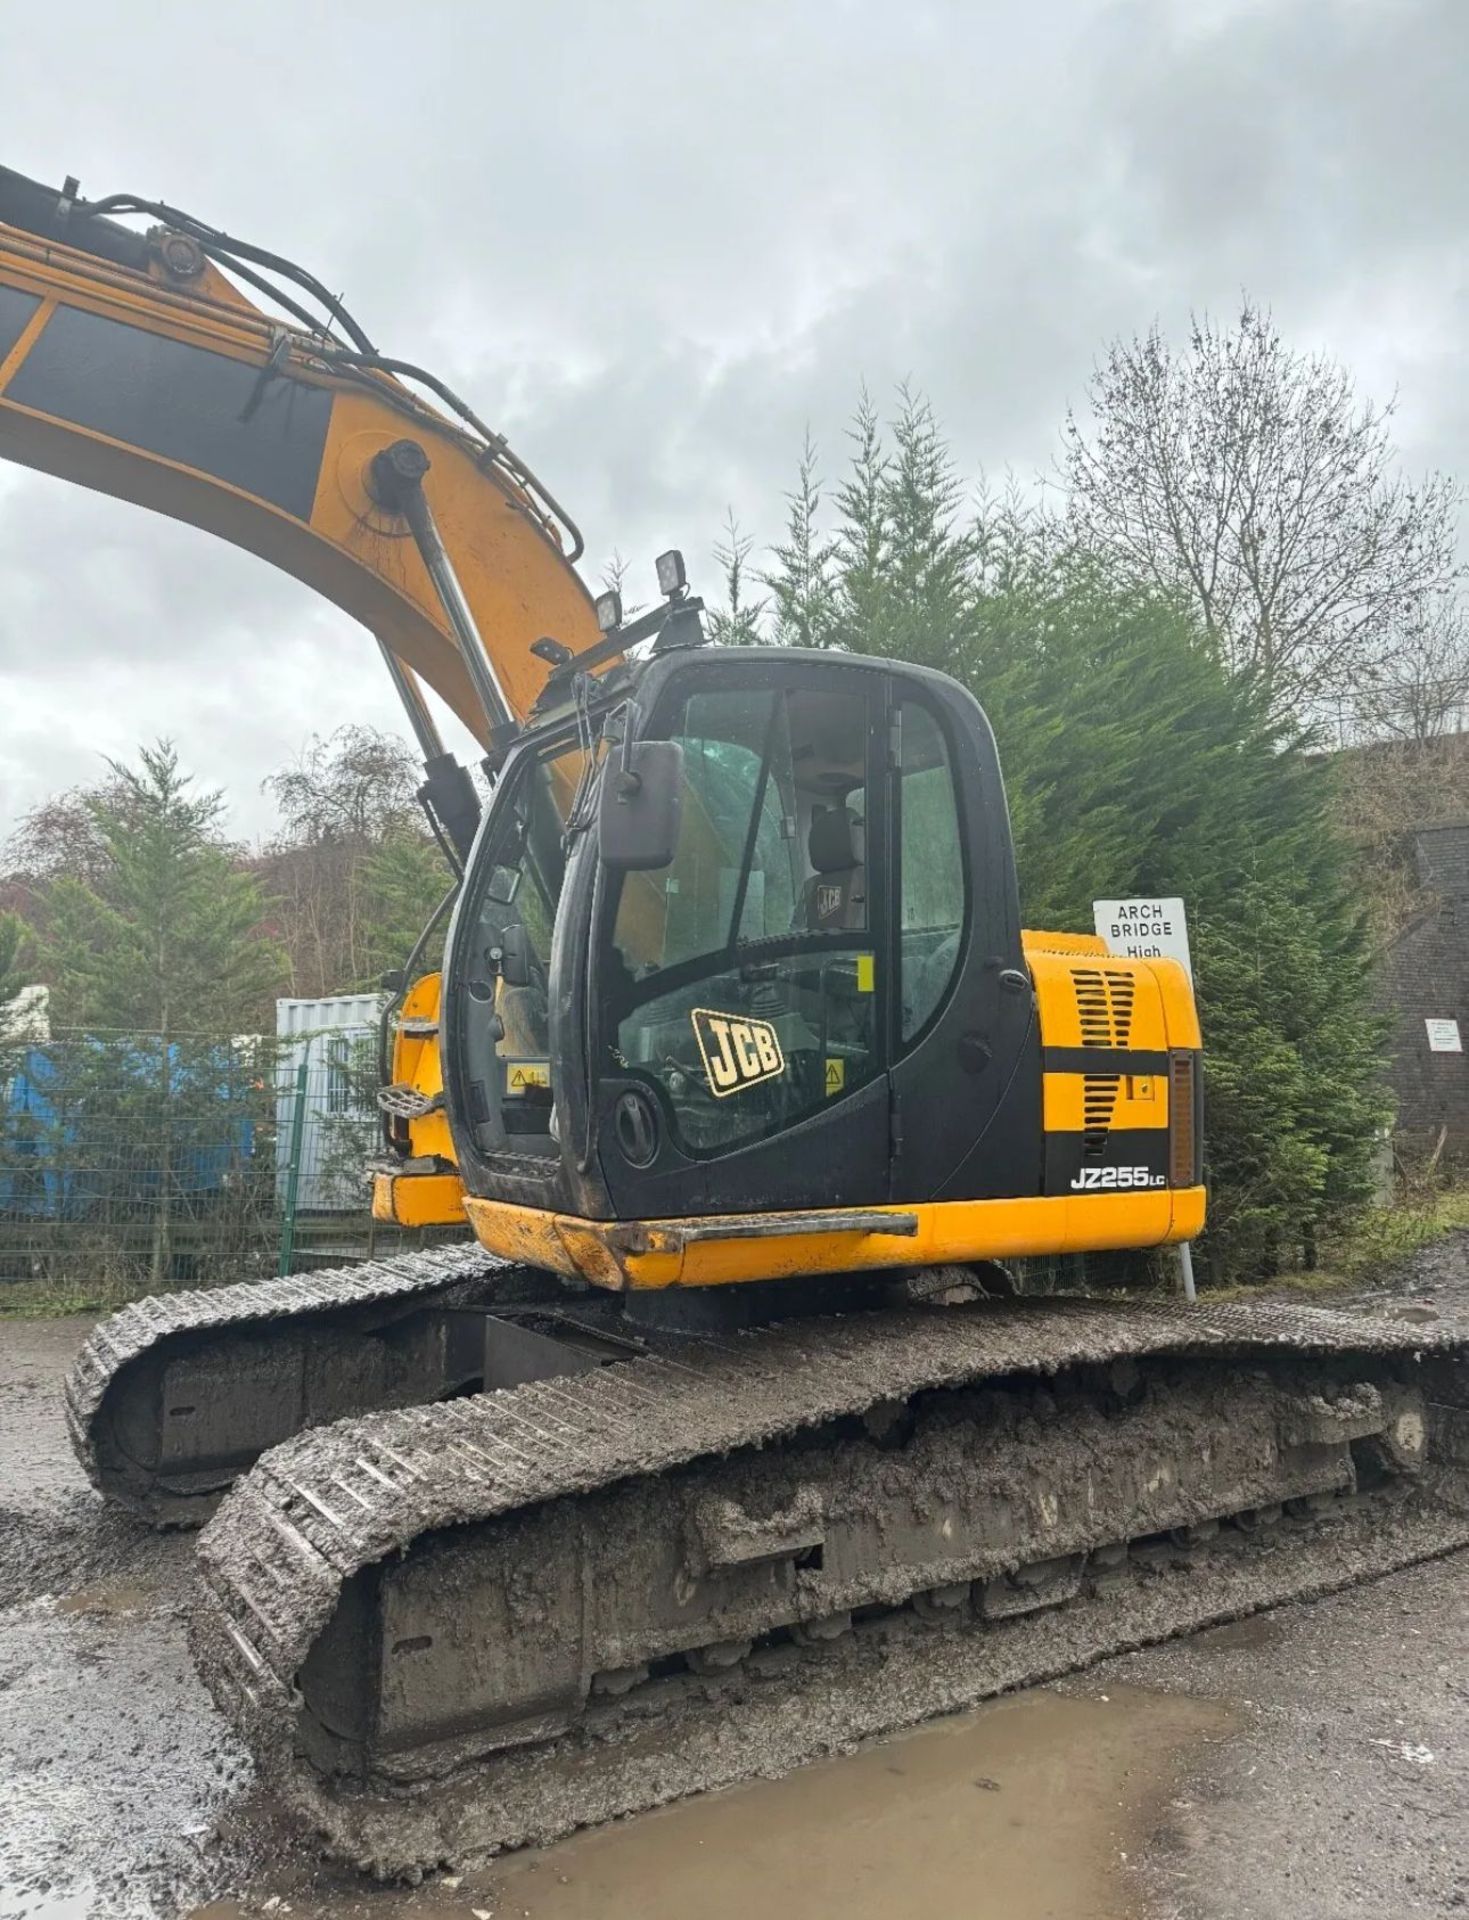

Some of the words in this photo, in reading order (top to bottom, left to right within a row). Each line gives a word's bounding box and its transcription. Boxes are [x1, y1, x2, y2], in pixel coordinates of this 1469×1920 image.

[1118, 905, 1162, 919] ARCH
[1111, 922, 1172, 937] BRIDGE
[708, 1018, 779, 1086] JCB
